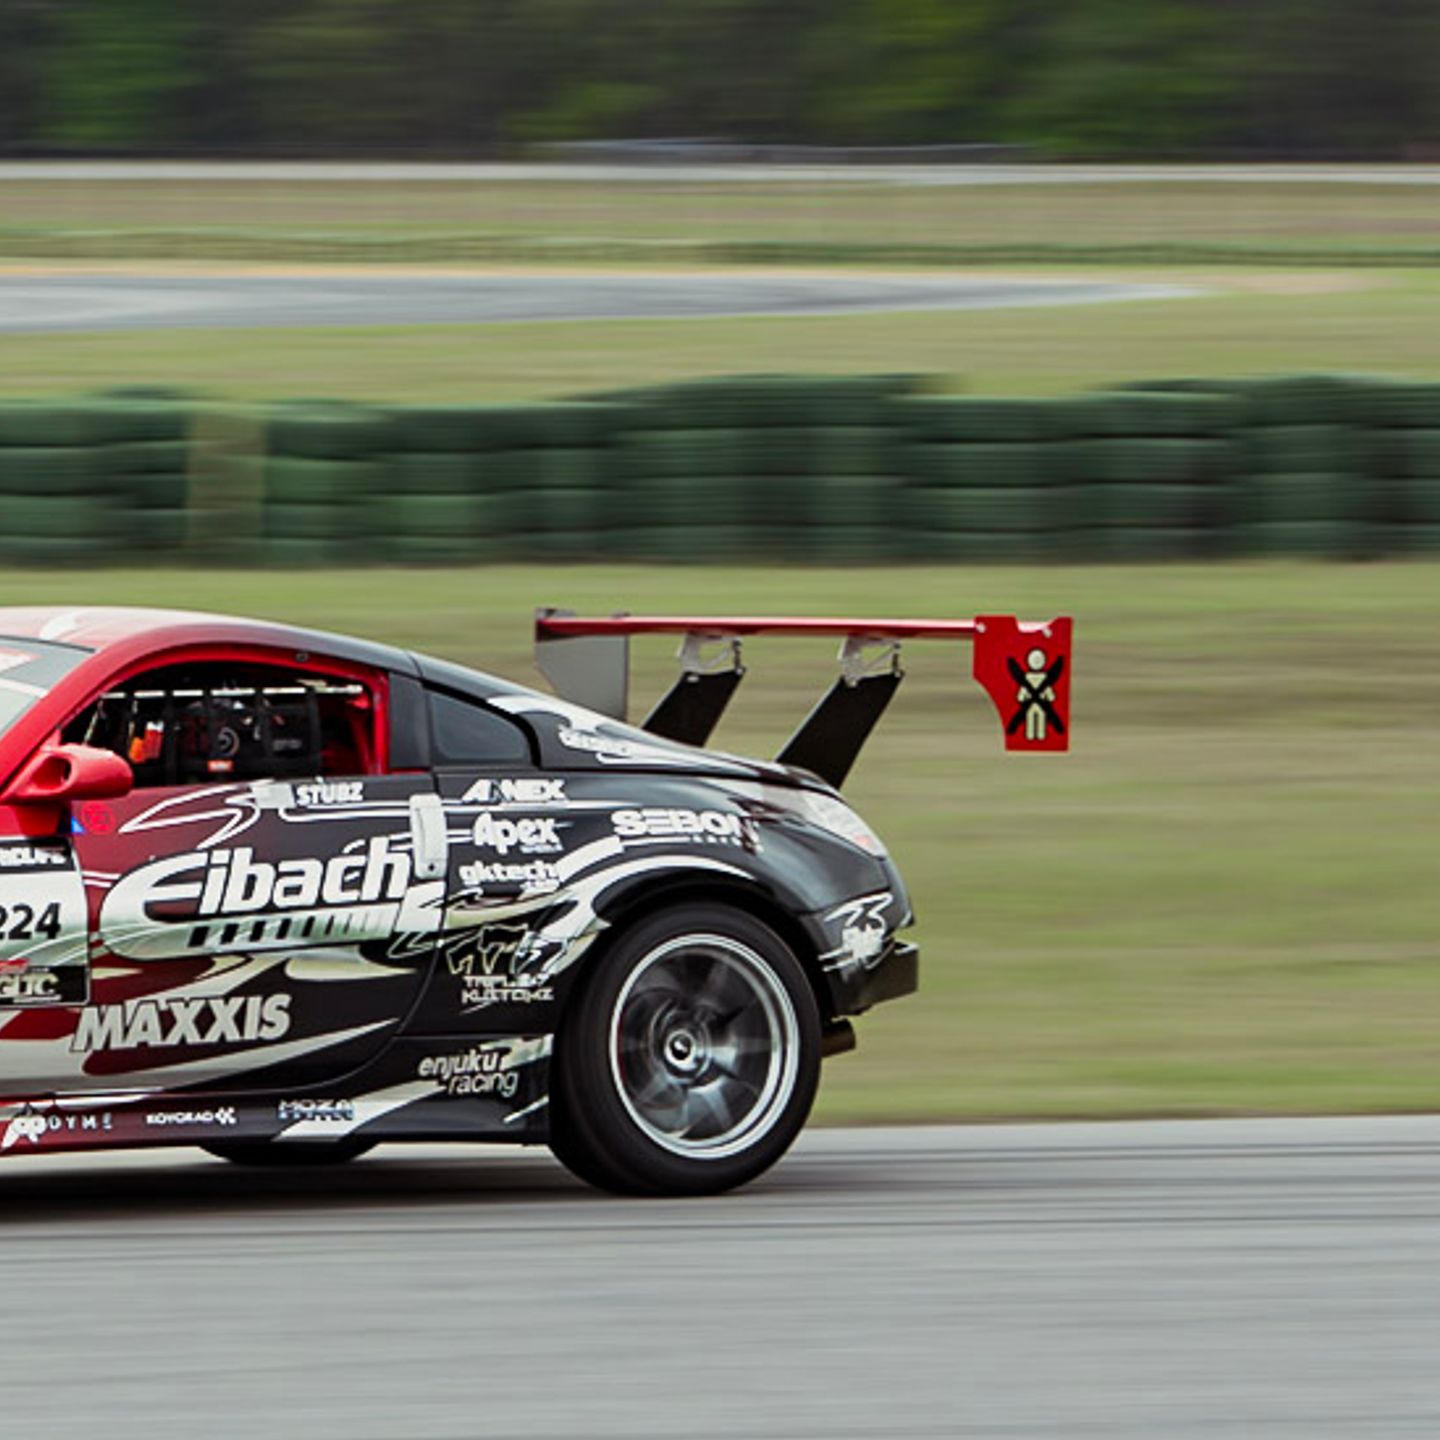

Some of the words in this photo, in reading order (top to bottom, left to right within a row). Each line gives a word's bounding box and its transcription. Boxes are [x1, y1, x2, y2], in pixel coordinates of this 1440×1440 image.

[297, 781, 364, 806] STUBZ
[473, 811, 561, 854] Apex
[100, 836, 415, 950] Eibach
[70, 992, 294, 1053] MAXXIS
[418, 1048, 499, 1081] enjuku
[448, 1071, 520, 1098] racing
